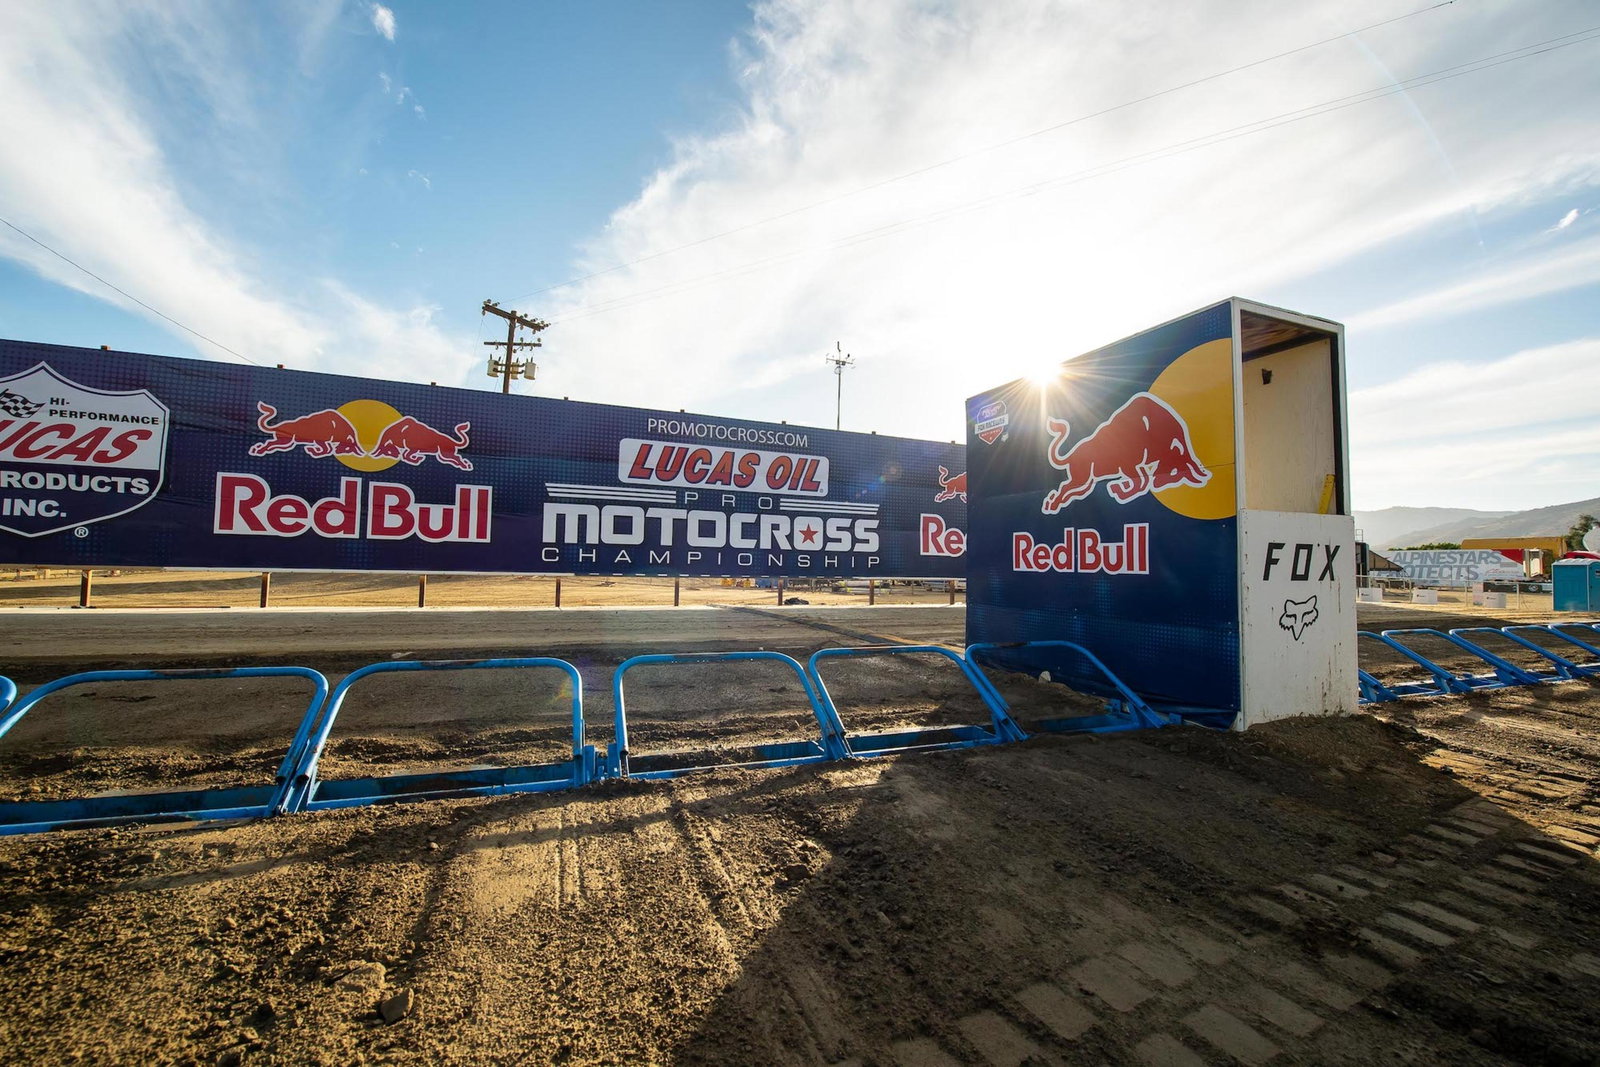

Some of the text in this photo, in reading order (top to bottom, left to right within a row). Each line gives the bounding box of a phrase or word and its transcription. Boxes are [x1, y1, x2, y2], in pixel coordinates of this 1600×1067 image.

[50, 397, 70, 406] HI-
[49, 409, 159, 425] PERFORMANCE
[0, 419, 152, 463] UCAS
[647, 418, 808, 447] PROMOTOCROSS.COM
[628, 443, 823, 493] LUCAS OIL
[0, 471, 150, 494] RODUCTS
[3, 498, 67, 517] INC.
[215, 474, 491, 541] Red Bull
[685, 492, 773, 511] PRO
[542, 502, 880, 553] MOTOCROSS
[921, 515, 967, 556] Re
[541, 547, 881, 568] CHAMPIONSHIP
[1014, 525, 1148, 573] Red Bull
[1263, 542, 1340, 581] FOX
[1392, 550, 1501, 565] ALPINESTARS
[1377, 564, 1479, 580] OTECTS
